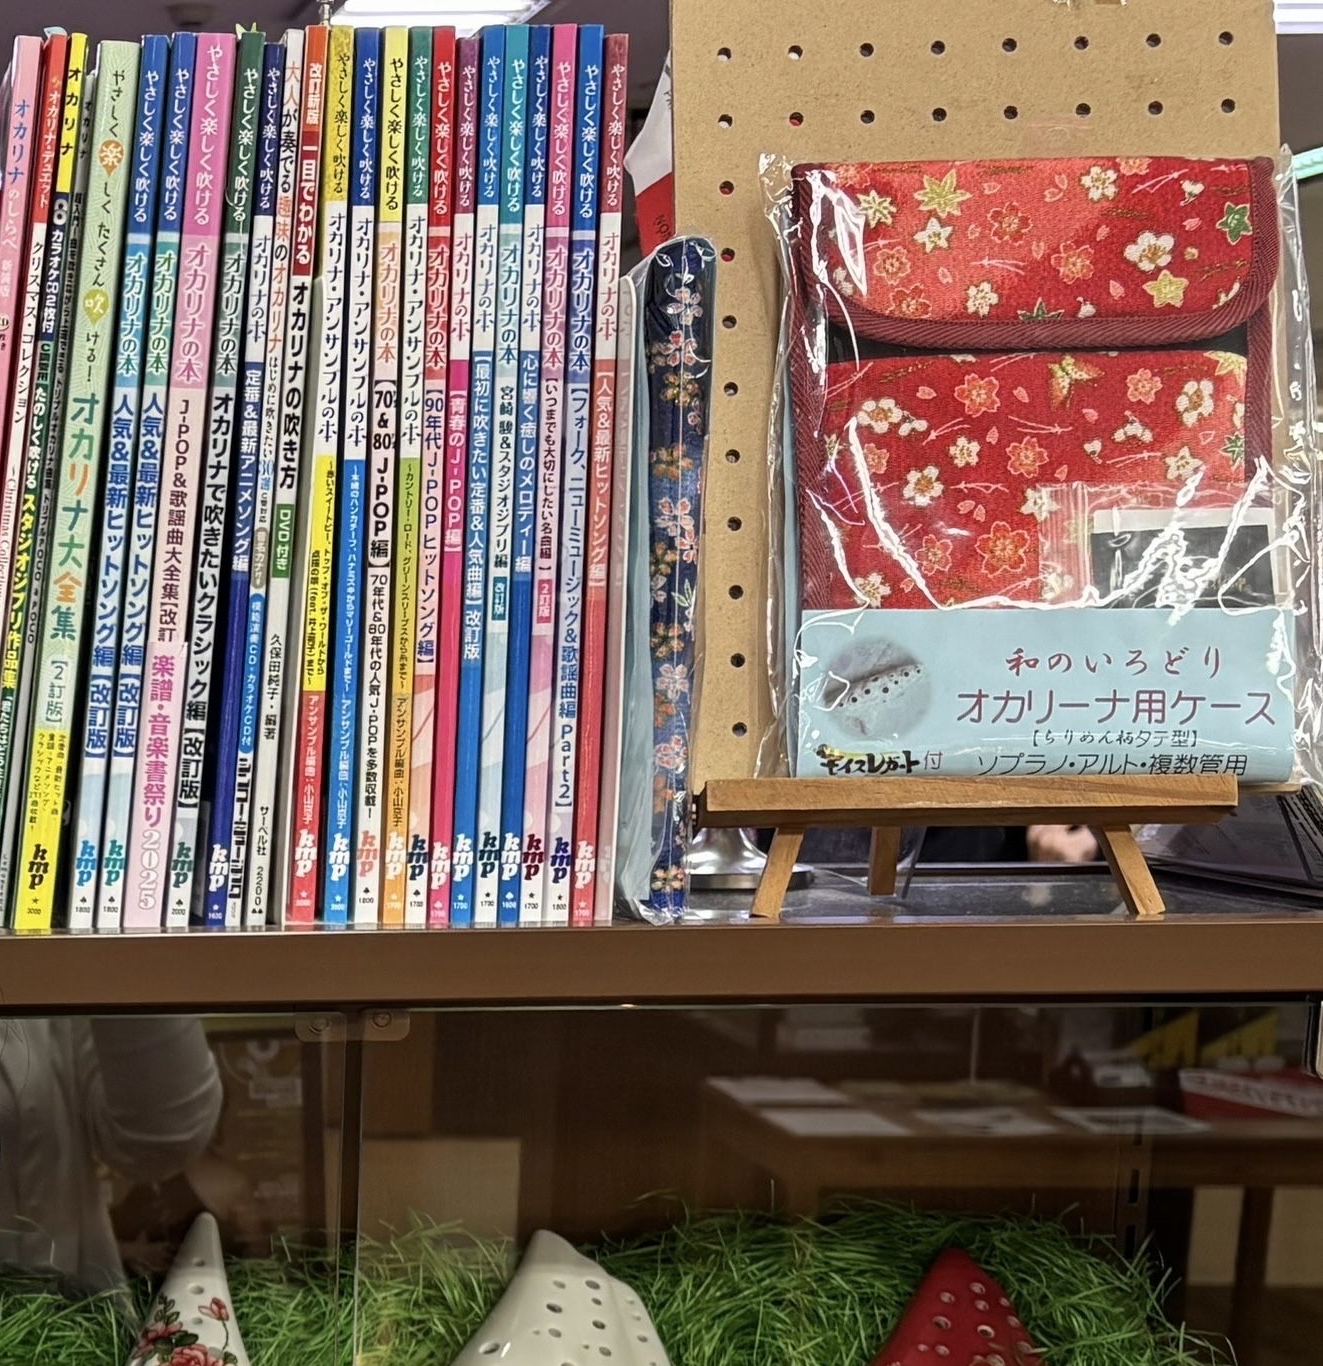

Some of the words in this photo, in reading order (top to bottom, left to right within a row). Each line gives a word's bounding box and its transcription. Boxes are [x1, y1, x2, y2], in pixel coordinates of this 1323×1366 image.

[39, 90, 62, 209] オカリナ・デュエット
[60, 67, 82, 156] オカリナ
[132, 70, 159, 223] やさしく楽しく吹ける
[164, 68, 190, 221] やさしく楽しく吹ける
[193, 43, 223, 226] やさしく楽しく吹ける
[232, 68, 259, 222] やさしく楽しく吹ける
[259, 67, 281, 209] やさしく楽しく吹ける
[332, 53, 351, 194] やさしく楽しく吹ける
[358, 58, 376, 200] やさしく楽しく吹ける
[384, 57, 404, 211] やさしく楽しく吹ける
[411, 55, 429, 197] やさしく楽しく吹ける
[434, 60, 452, 215] やさしく楽しく吹ける
[457, 64, 476, 207] やさしく楽しく吹ける
[482, 55, 501, 198] やさしく楽しく吹ける
[506, 58, 526, 213] やさしく楽しく吹ける
[530, 55, 548, 198] やさしく楽しく吹ける
[552, 62, 571, 216] やさしく楽しく吹ける
[579, 64, 599, 218] やさしく楽しく吹ける
[606, 63, 626, 207] やさしく楽しく吹ける
[1, 100, 30, 250] オカリナのしらべ
[295, 145, 319, 266] 一目でわかる
[13, 241, 44, 425] クリスマス・コレクション
[116, 251, 147, 377] オカリナの本
[147, 250, 176, 374] オカリナの本
[175, 243, 212, 383] オカリナの本
[215, 252, 247, 375] オカリナの本
[247, 235, 272, 343] オカリナの本
[318, 212, 346, 443] オカリナ・アンサンブルの本
[346, 217, 374, 447] オカリナ・アンサンブルの本
[376, 243, 399, 363] オカリナの本
[400, 216, 427, 445] オカリナ・アンサンブルの本
[426, 245, 450, 372] オカリナの本
[450, 232, 474, 342] オカリナの本
[474, 223, 497, 333] オカリナの本
[498, 243, 521, 365] オカリナの本
[522, 223, 545, 333] オカリナの本
[542, 246, 567, 370] オカリナの本
[569, 249, 595, 371] オカリナの本
[596, 232, 621, 342] オカリナの本
[25, 386, 47, 490] たのしく吹ける
[278, 282, 309, 490] オカリナの吹き方
[51, 392, 100, 642] オカリナ大全集
[232, 369, 262, 573] 定番&最新アニメソング編
[2, 494, 37, 690] スタジオジブリ作品集
[275, 509, 292, 571] DVD付き
[46, 659, 70, 724] 【2訂版】
[464, 610, 482, 660] 改訂版
[1005, 645, 1222, 678] 和のいろどり
[957, 689, 1276, 727] オカリーナ用ケース
[976, 752, 1248, 777] ソプラノ・アルト・複数管用
[1031, 728, 1199, 749] 【ちりめん柄タテ型】
[28, 844, 50, 890] kmp
[76, 840, 97, 887] kmp
[208, 844, 228, 892] kmp
[255, 866, 264, 906] 2200
[257, 806, 270, 856] サーベル社
[294, 829, 317, 878] kmp
[356, 831, 378, 877] kmp
[430, 841, 451, 890] kmp
[452, 833, 474, 881] kmp
[478, 831, 500, 878] kmp
[500, 832, 520, 881] kmp
[522, 833, 544, 881] kmp
[550, 837, 571, 883] kmp
[574, 840, 596, 890] kmp
